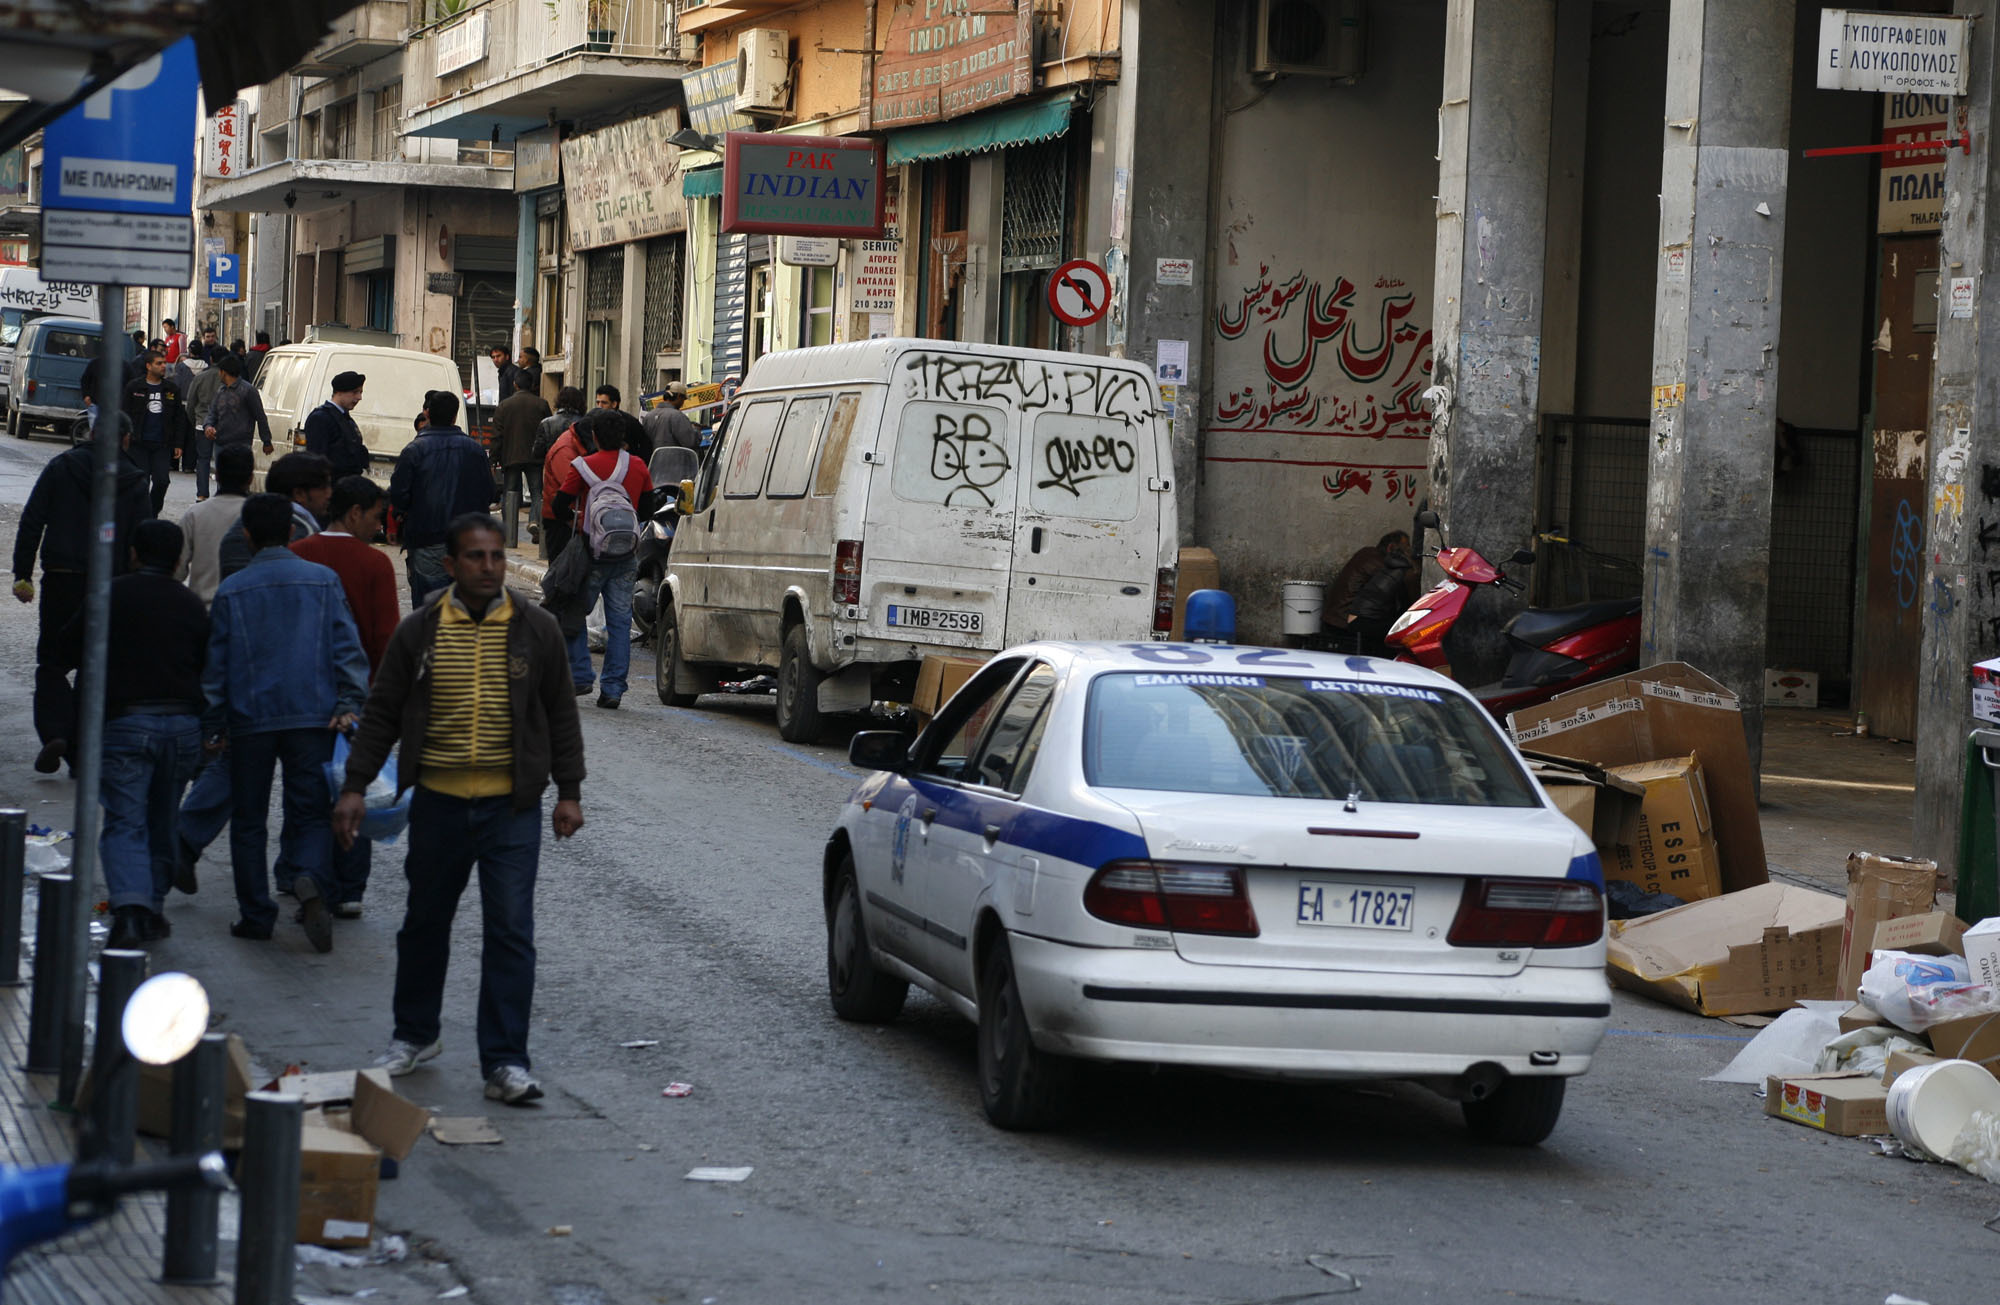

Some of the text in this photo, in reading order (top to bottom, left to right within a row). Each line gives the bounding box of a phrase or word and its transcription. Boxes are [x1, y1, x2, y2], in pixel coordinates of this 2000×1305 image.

[909, 15, 987, 55] INDIAN
[1843, 24, 1947, 46] ΤΥΠΟΓΡΑΦΕΙΟΝ
[1830, 49, 1958, 74] Ε. ΛΟΥΚΟΠΟΥΛΟΣ
[877, 70, 911, 93] CAFE
[912, 68, 922, 88] &
[784, 151, 838, 171] PAK
[63, 169, 174, 193] ΜΕ ΠΛΗΡΩΜΗ
[744, 173, 870, 200] INDIAN
[1889, 172, 1946, 202] ΠΩΛΗ
[595, 190, 655, 223] ΣΠΑΡΤΗΣ
[744, 204, 872, 224] RESTAURANT
[862, 240, 898, 252] SERVIC
[216, 257, 232, 277] P
[868, 254, 897, 264] ΑΓΟΡΕΣ
[856, 277, 897, 286] ΑΝΤΑΛΛΑ
[854, 300, 896, 309] 210 3237
[904, 608, 981, 631] IMB-2598
[1135, 674, 1442, 703] ΕΛΛΗΝΙΚΗ ΑΣΤΥΝΟΜΙΑ
[1661, 821, 1690, 881] ESSE
[1298, 886, 1412, 927] EA 17827
